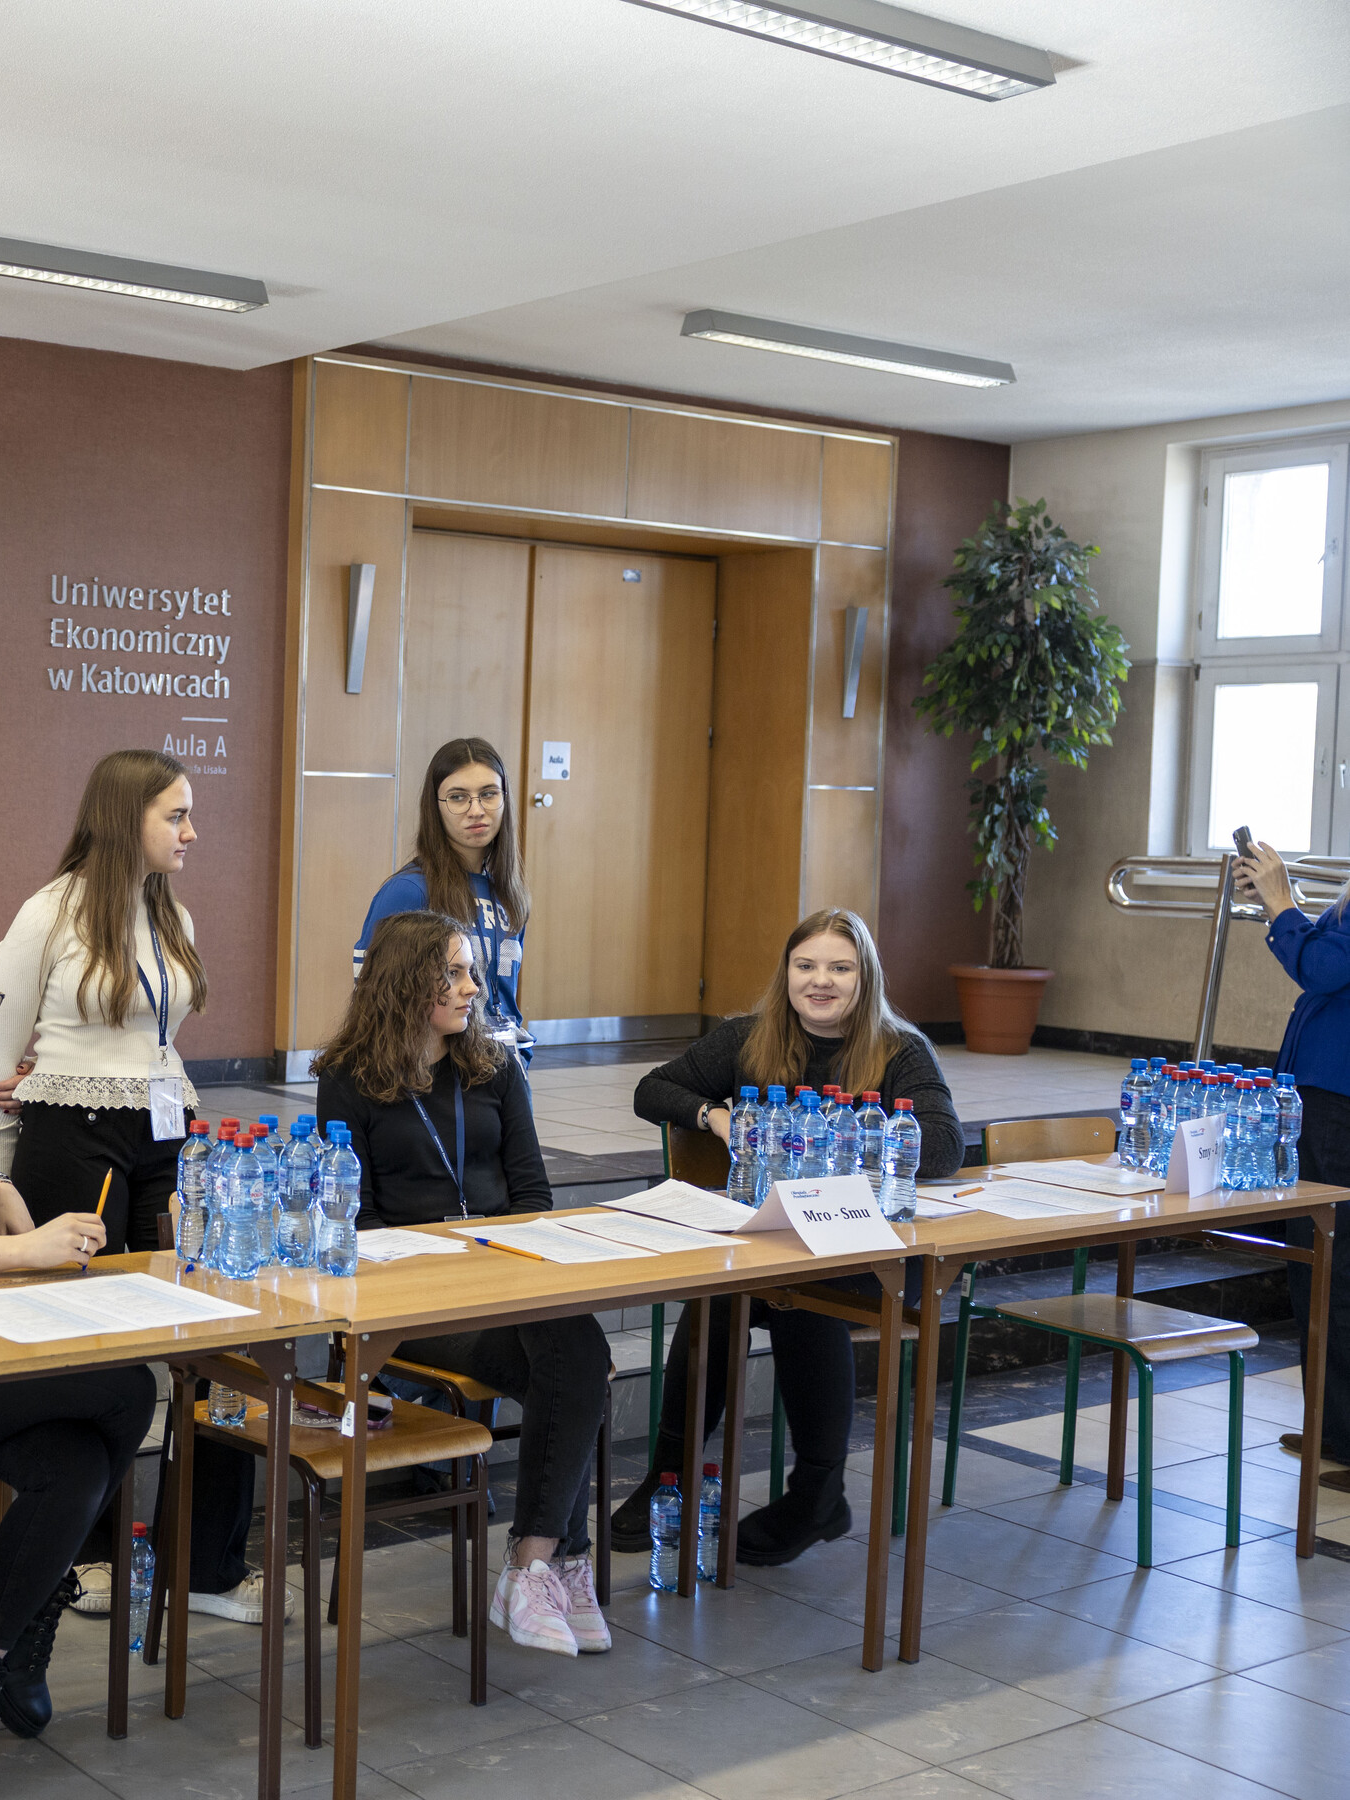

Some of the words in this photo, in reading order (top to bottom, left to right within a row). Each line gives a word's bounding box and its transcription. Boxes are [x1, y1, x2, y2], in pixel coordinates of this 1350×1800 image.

[51, 574, 232, 620] Uniwersytet
[50, 617, 231, 665] Ekonomiczny
[47, 667, 74, 692] w
[81, 662, 230, 699] Katowicach
[162, 732, 207, 758] Aula
[214, 735, 228, 758] A
[203, 764, 228, 775] Lisaka
[548, 755, 565, 764] Aula
[1198, 1146, 1212, 1161] Smy
[802, 1209, 832, 1223] Mro
[840, 1206, 872, 1220] Smu
